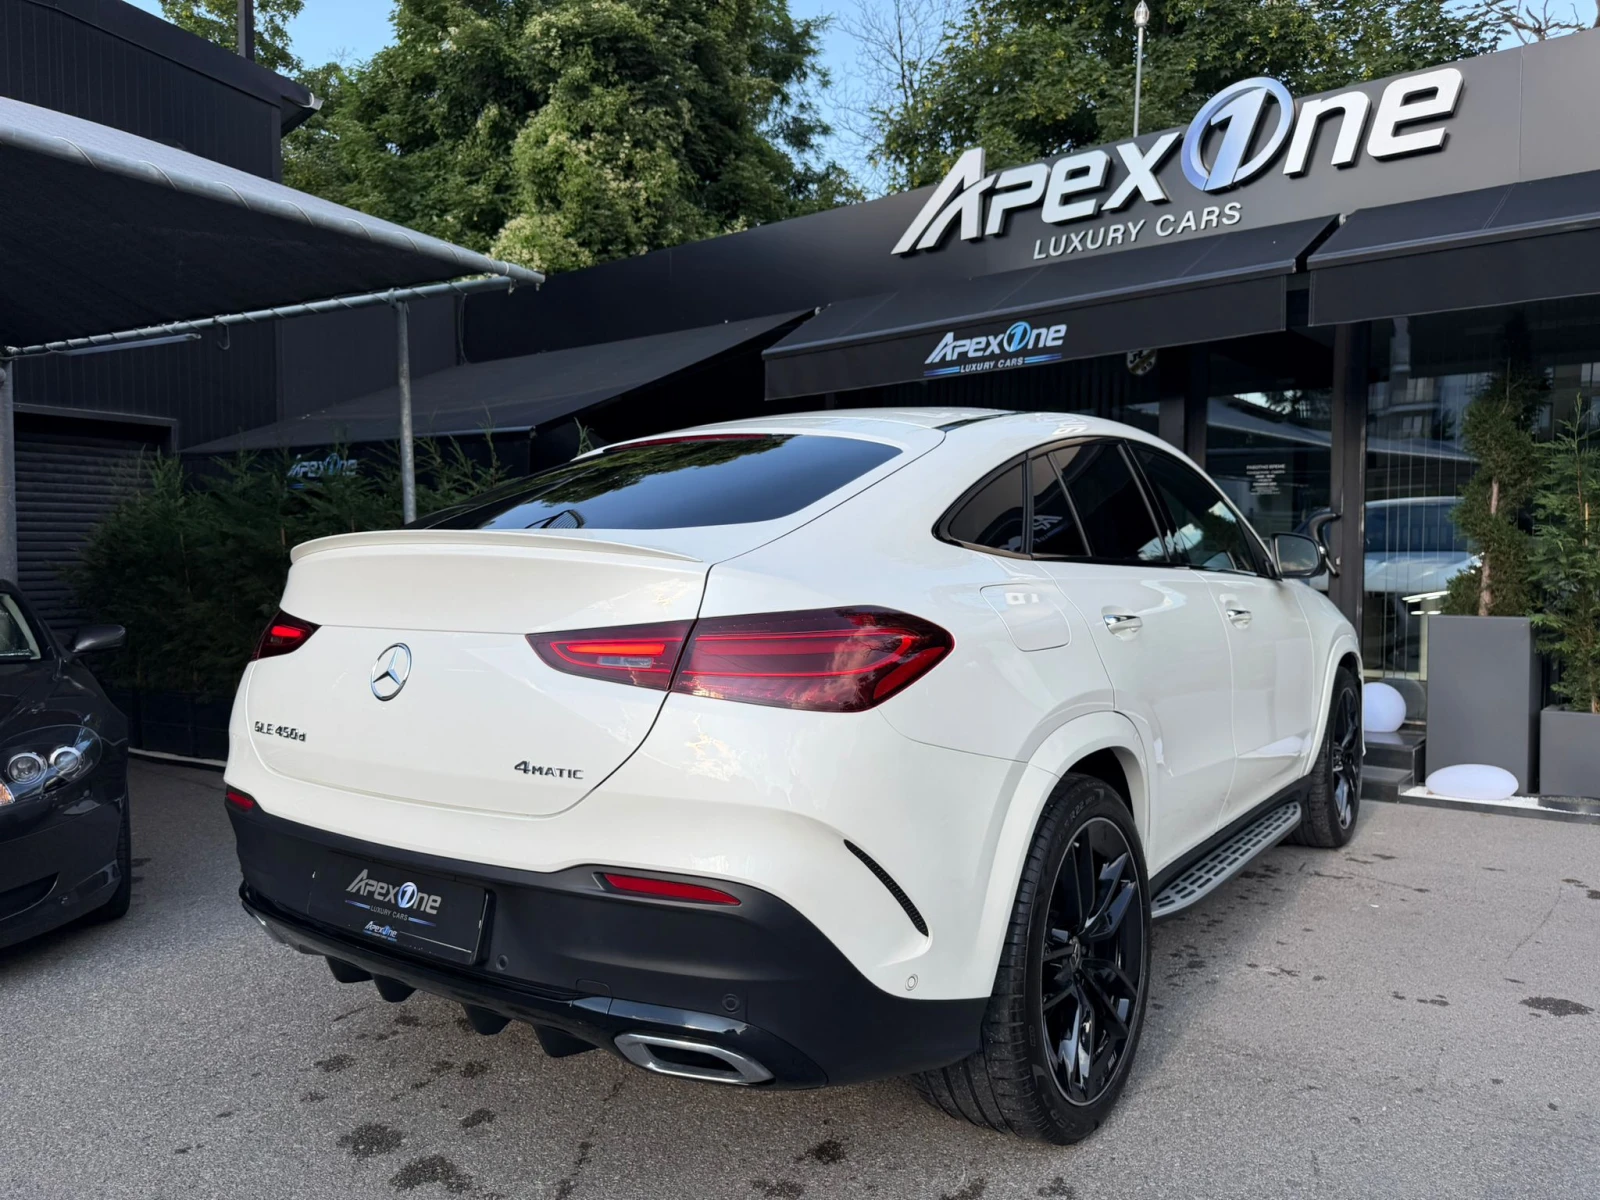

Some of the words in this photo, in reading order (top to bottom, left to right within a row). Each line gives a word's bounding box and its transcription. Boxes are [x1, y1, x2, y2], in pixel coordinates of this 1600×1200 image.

[1033, 219, 1147, 260] LUXURY
[1155, 202, 1243, 238] CARS
[960, 361, 996, 373] LUXURY
[998, 356, 1024, 369] CARS
[254, 720, 274, 736] GLE
[514, 760, 584, 780] 4MATIC
[370, 905, 392, 917] LUXURY
[392, 911, 409, 921] CARS
